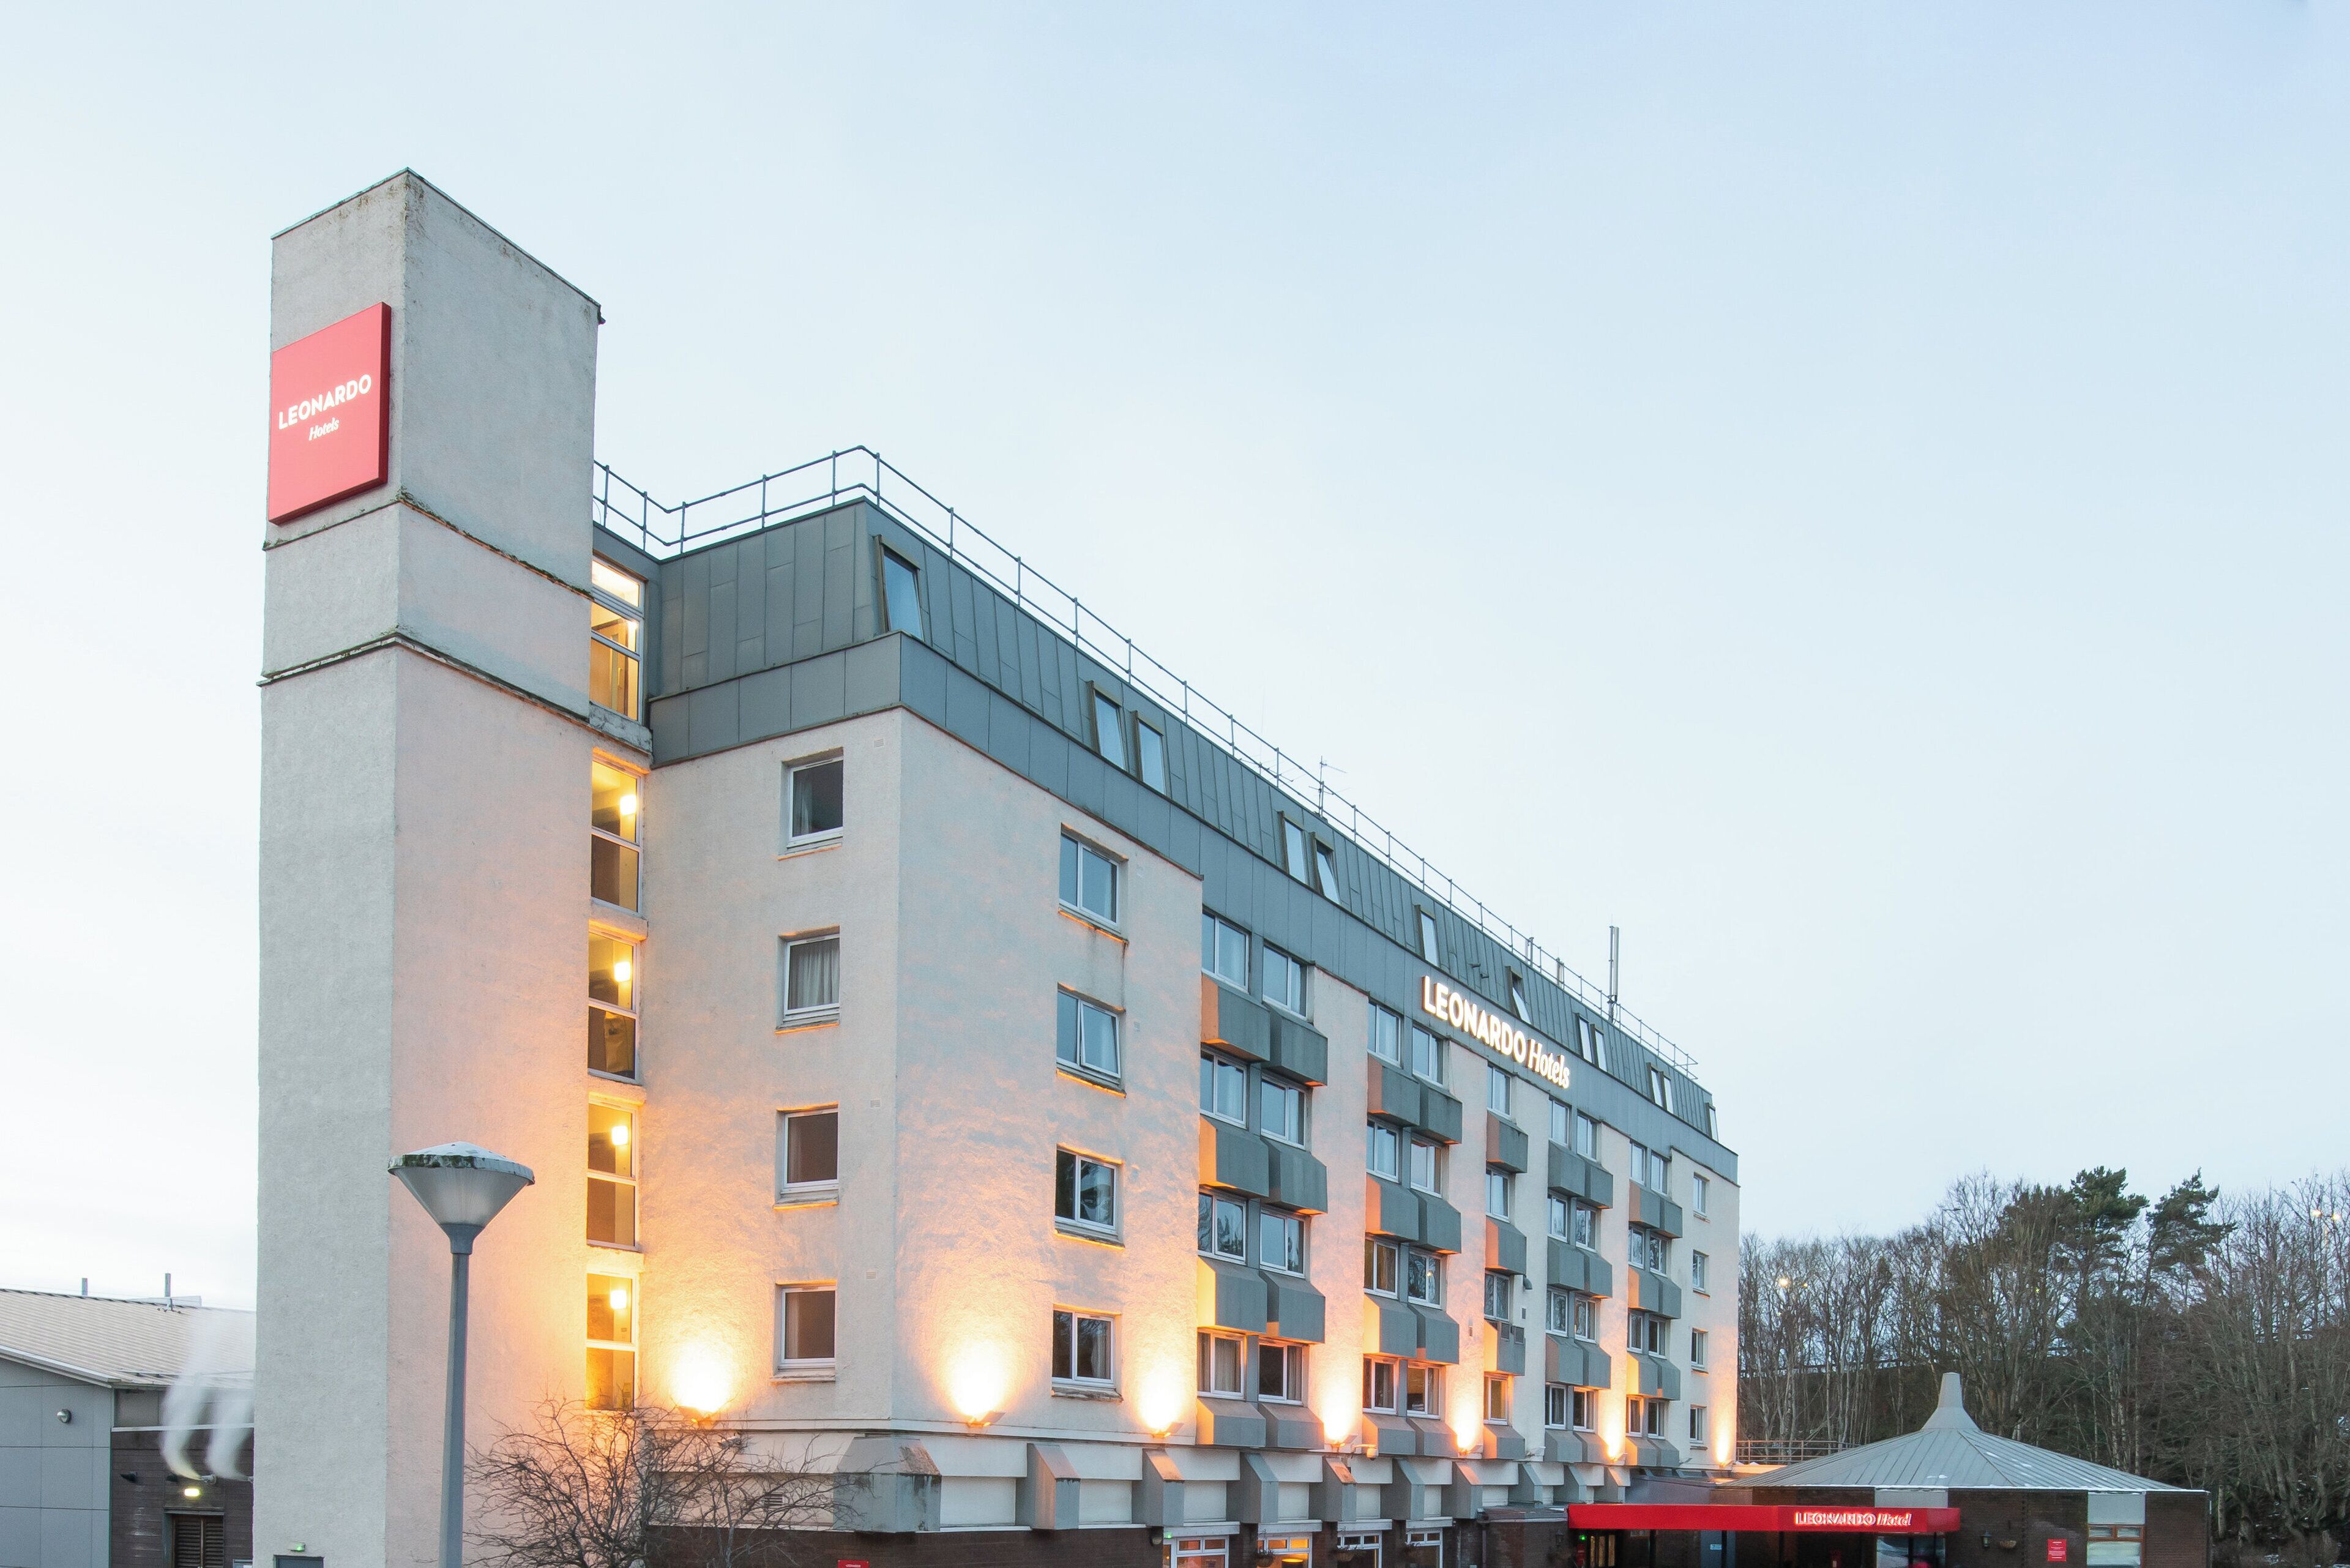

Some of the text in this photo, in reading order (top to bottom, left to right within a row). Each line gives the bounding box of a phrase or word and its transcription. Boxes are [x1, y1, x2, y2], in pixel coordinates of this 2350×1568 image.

[278, 374, 371, 430] LEONARDO
[308, 417, 340, 441] Hotels
[1422, 975, 1570, 1089] LEONARDO Hotels
[1795, 1512, 1912, 1526] LEONARDO Hotel
